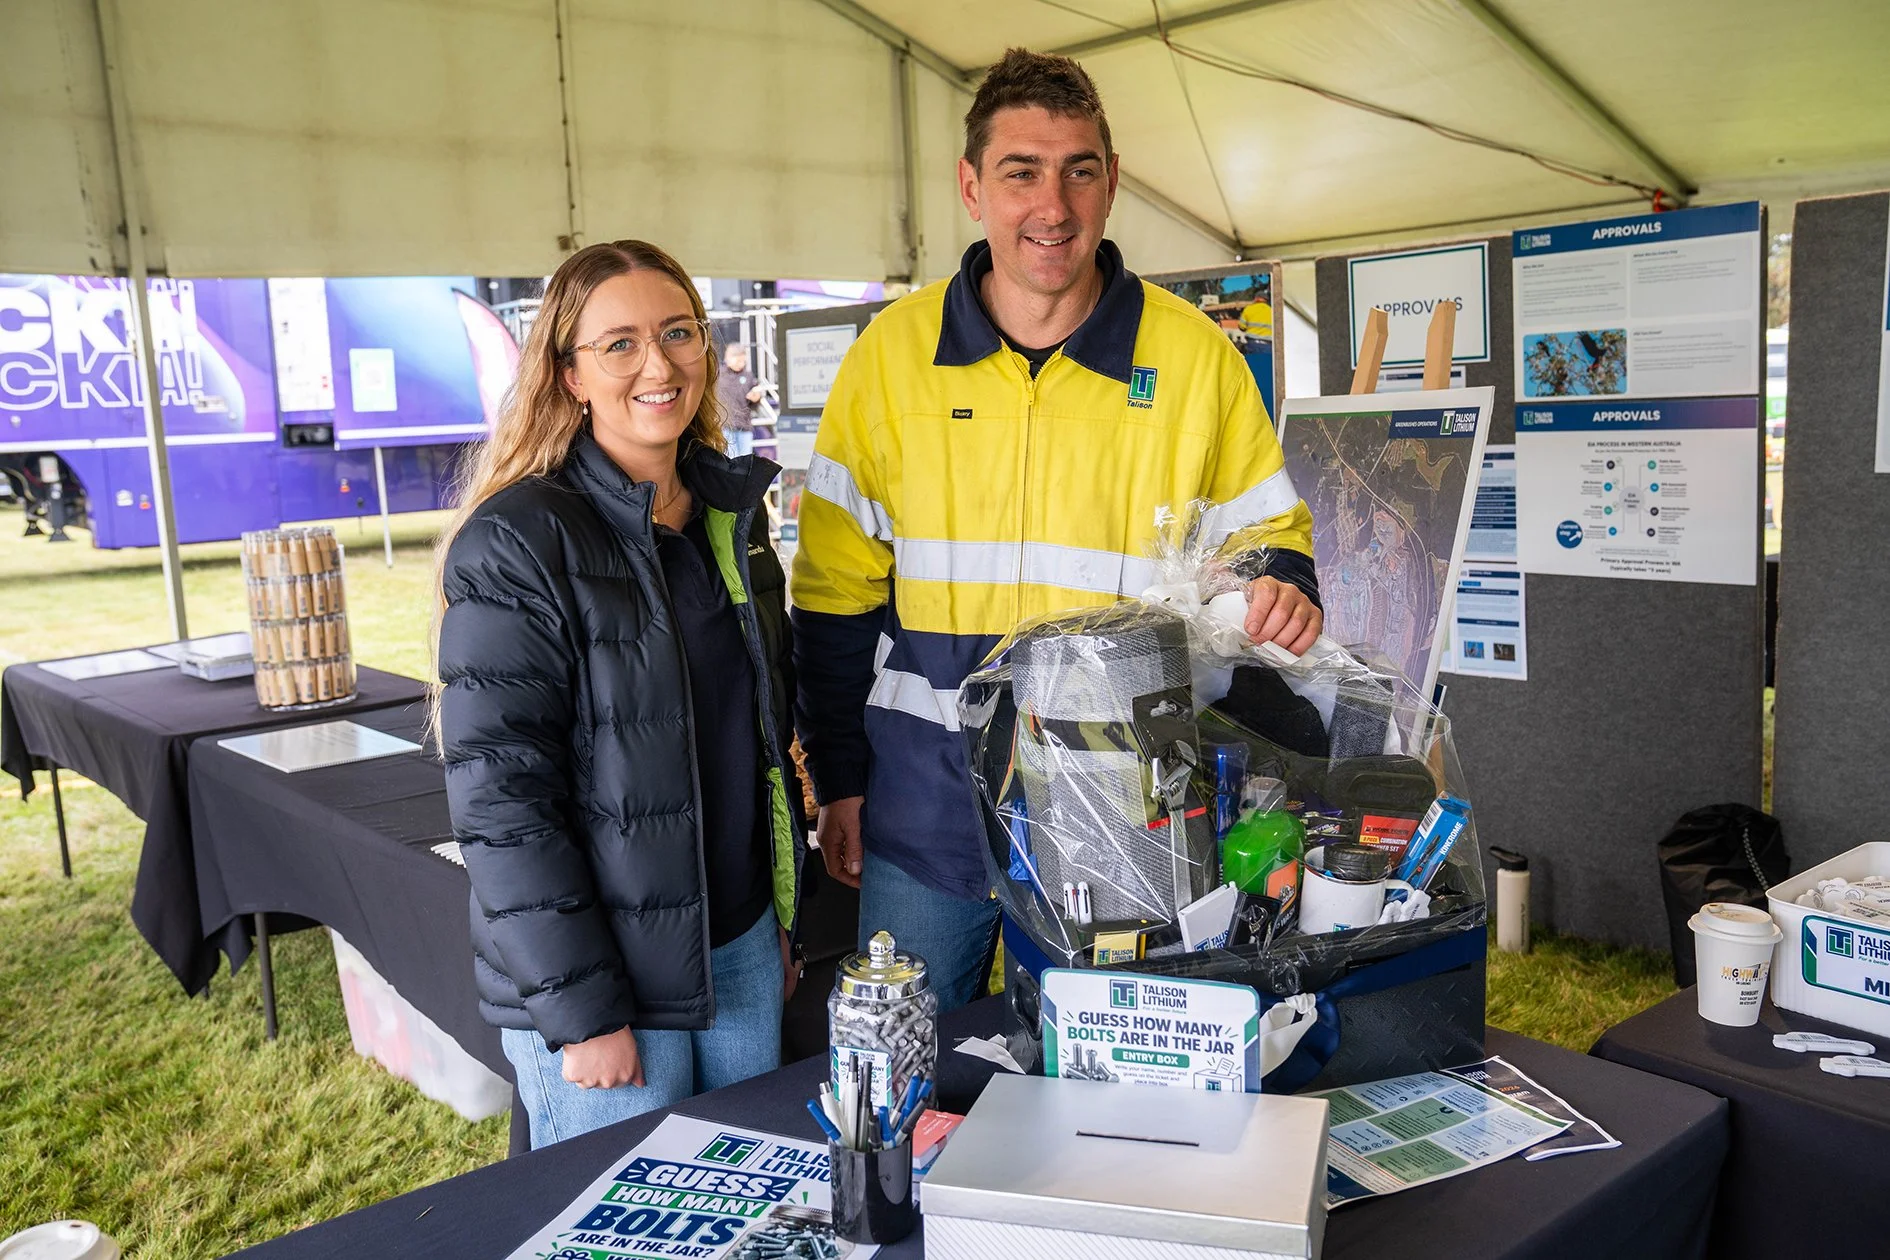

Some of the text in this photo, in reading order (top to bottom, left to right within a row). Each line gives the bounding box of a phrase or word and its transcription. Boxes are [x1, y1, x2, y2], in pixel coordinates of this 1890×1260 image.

[1592, 221, 1662, 240] APPROVALS
[1376, 297, 1463, 316] PPROVS
[1127, 400, 1153, 409] Talison
[1455, 413, 1477, 423] TALISON
[1593, 409, 1661, 422] APPROVALS
[1453, 422, 1475, 432] LITHIUM
[1439, 821, 1463, 855] KINCROME
[1142, 984, 1187, 998] TALISON
[1142, 995, 1187, 1009] LITHIUM
[1078, 1011, 1223, 1038] GUESS HOW MANY
[1067, 1026, 1235, 1055] BOLTS ARE IN THE JAR
[1122, 1051, 1179, 1065] ENTRY BOX
[771, 1145, 830, 1167] TALIS
[758, 1158, 831, 1182] LITHIU
[645, 1164, 773, 1197] GUESS
[611, 1185, 765, 1216] HOW MANY
[571, 1203, 748, 1246] BOLTS
[570, 1232, 715, 1259] ARE IN THE JAR?
